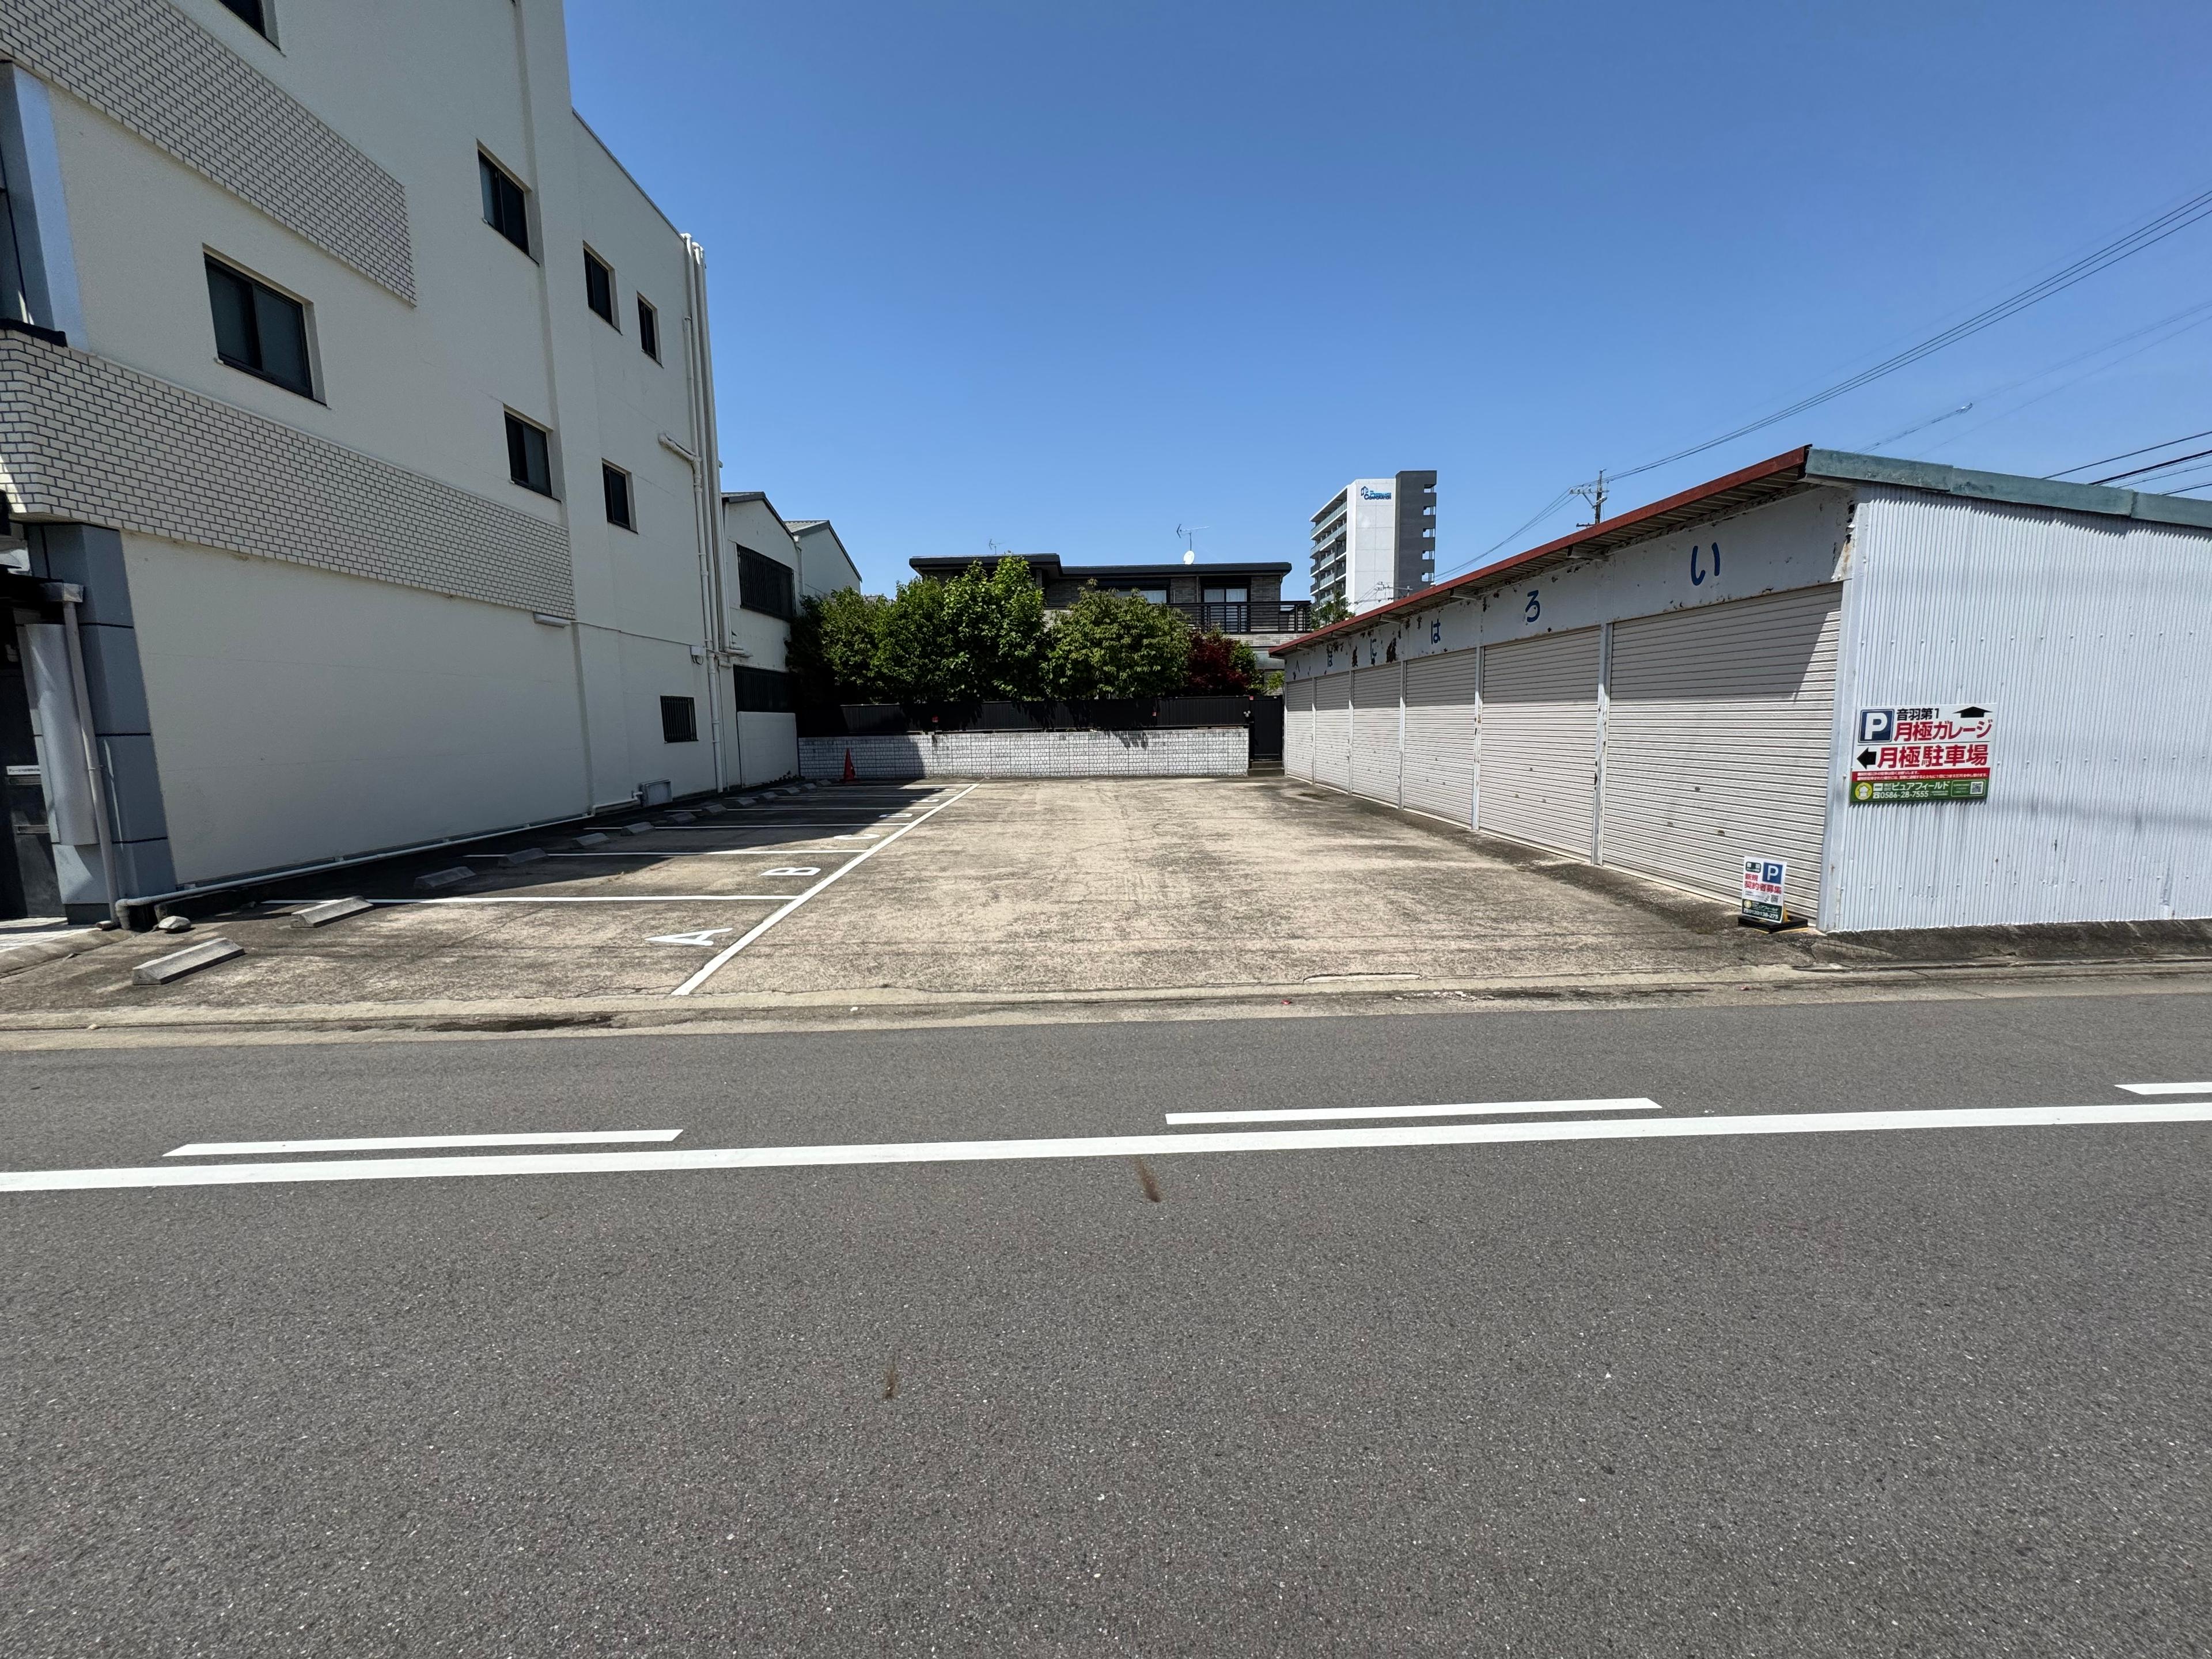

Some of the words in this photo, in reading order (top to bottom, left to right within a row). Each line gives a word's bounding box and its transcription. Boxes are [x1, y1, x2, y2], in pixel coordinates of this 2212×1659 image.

[1690, 542, 1720, 586] い
[1525, 590, 1541, 623] ろ
[1431, 618, 1441, 645] は
[1864, 712, 1888, 740] P
[1897, 708, 1940, 721] 音羽第1
[1893, 719, 1993, 741] 月極ガレージ
[1877, 744, 1988, 768] 月極駐車場
[759, 866, 821, 876] B
[1767, 865, 1779, 881] P
[644, 927, 733, 946] A
